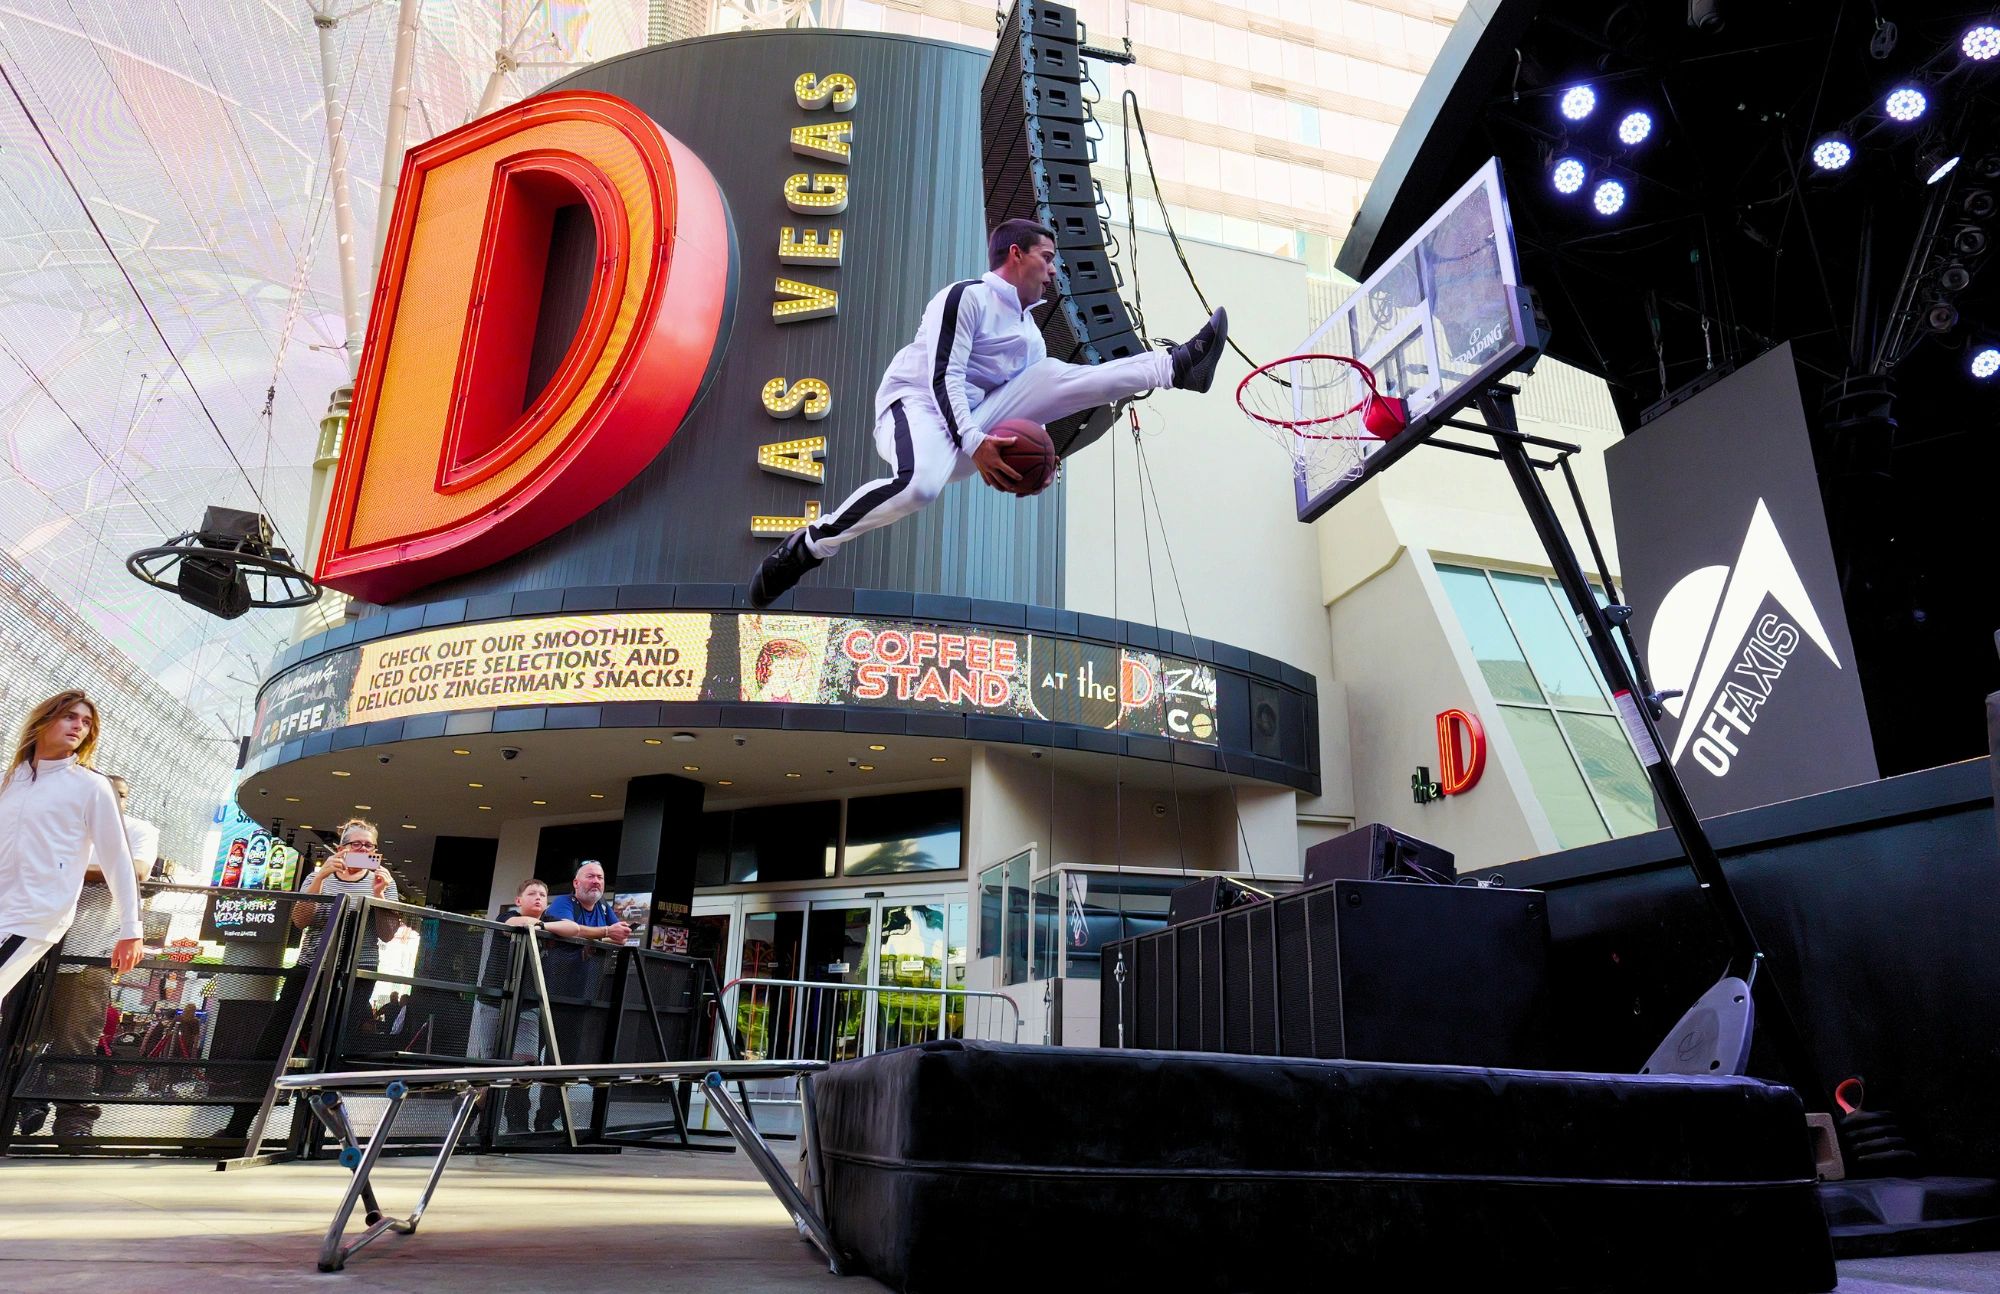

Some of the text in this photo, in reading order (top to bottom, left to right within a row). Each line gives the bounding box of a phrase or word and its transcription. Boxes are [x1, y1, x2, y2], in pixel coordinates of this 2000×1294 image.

[772, 72, 857, 325] VEGAS
[313, 90, 731, 605] D
[751, 377, 832, 538] LAS
[369, 648, 680, 690] ICED COFFEE SELECTIONS, AND
[379, 627, 670, 669] CHECK OUT OUR SMOOTHIES,
[842, 628, 1017, 675] COFFEE
[356, 669, 694, 713] DELICIOUS ZINGERMAN'S SNACKS!
[856, 664, 1009, 708] STAND
[1041, 658, 1153, 707] AT the D
[1168, 709, 1217, 739] CO
[1411, 708, 1487, 804] the D
[213, 911, 276, 924] VODKA SHOTS
[215, 899, 241, 912] MADE
[268, 900, 277, 911] 2
